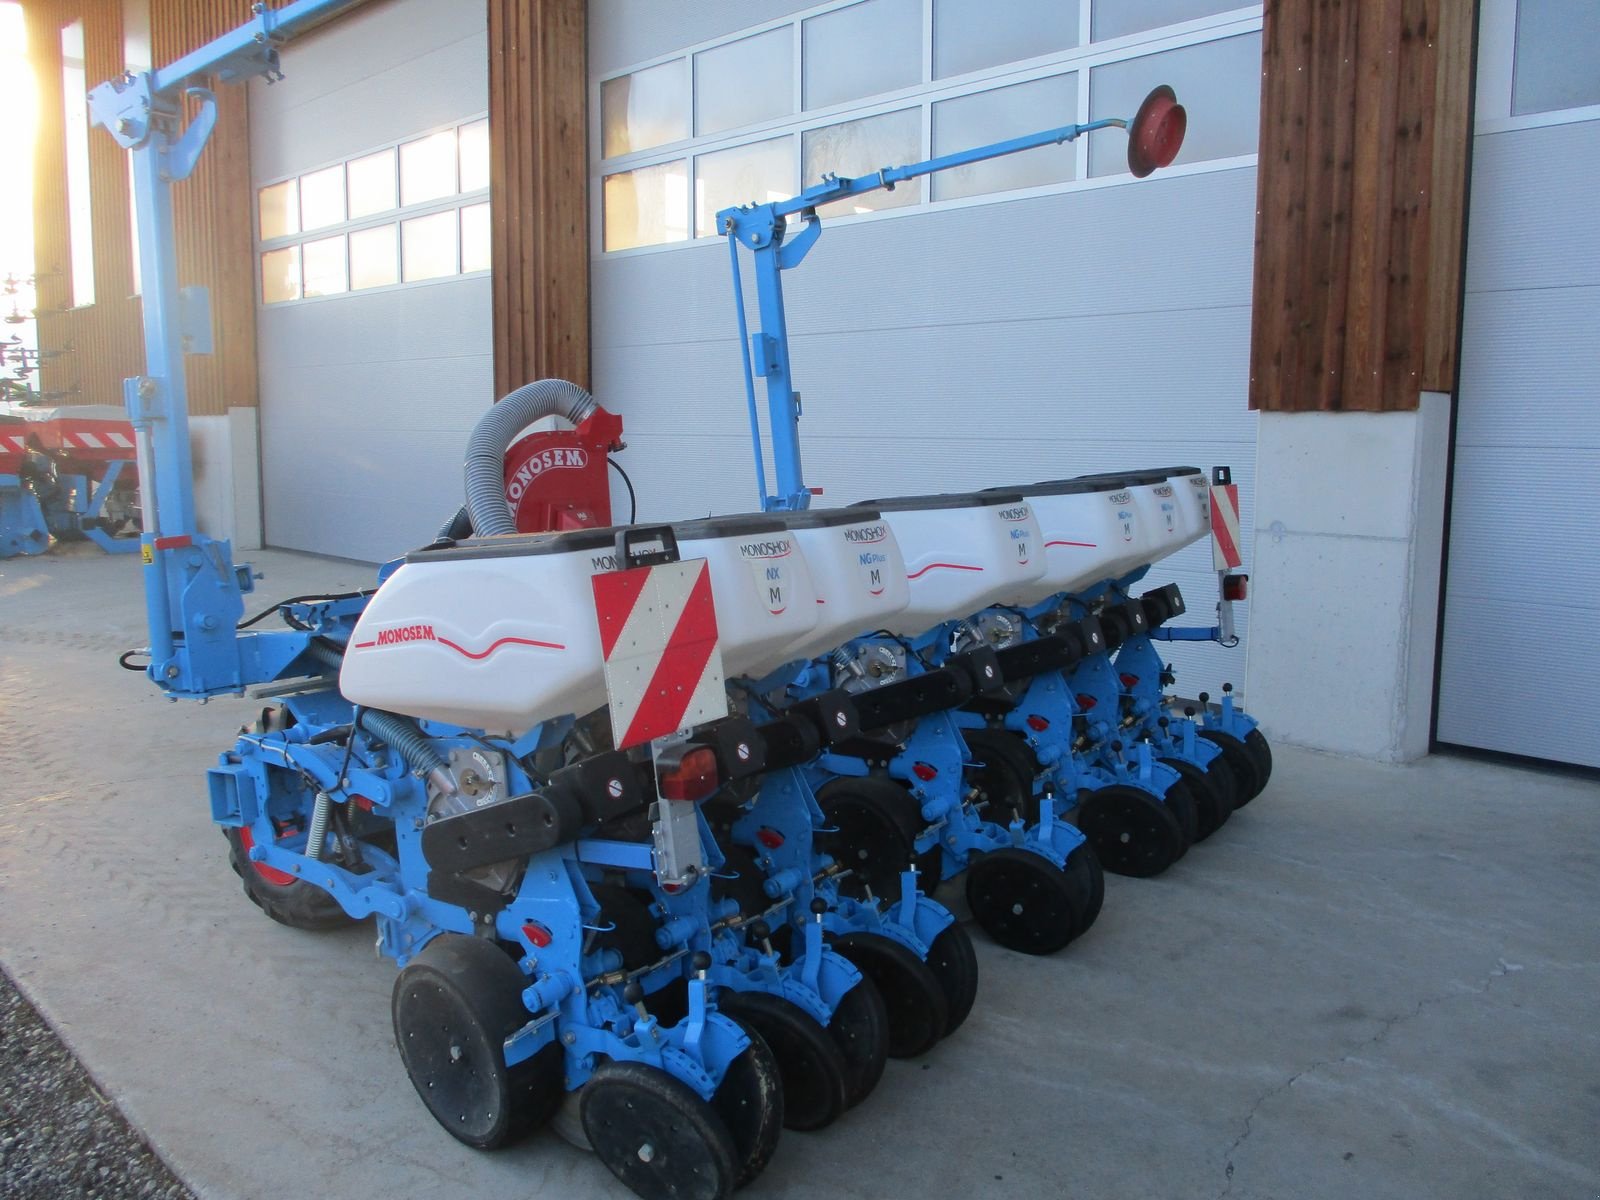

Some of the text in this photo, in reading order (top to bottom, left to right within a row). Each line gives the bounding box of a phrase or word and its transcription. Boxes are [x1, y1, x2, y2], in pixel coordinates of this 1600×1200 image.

[844, 525, 887, 542] MONOSHOX
[740, 540, 792, 557] MONOSHOX
[1018, 543, 1026, 557] M
[766, 567, 781, 581] NX
[870, 569, 881, 585] M
[769, 586, 782, 604] M
[377, 625, 436, 645] MONOSEM
